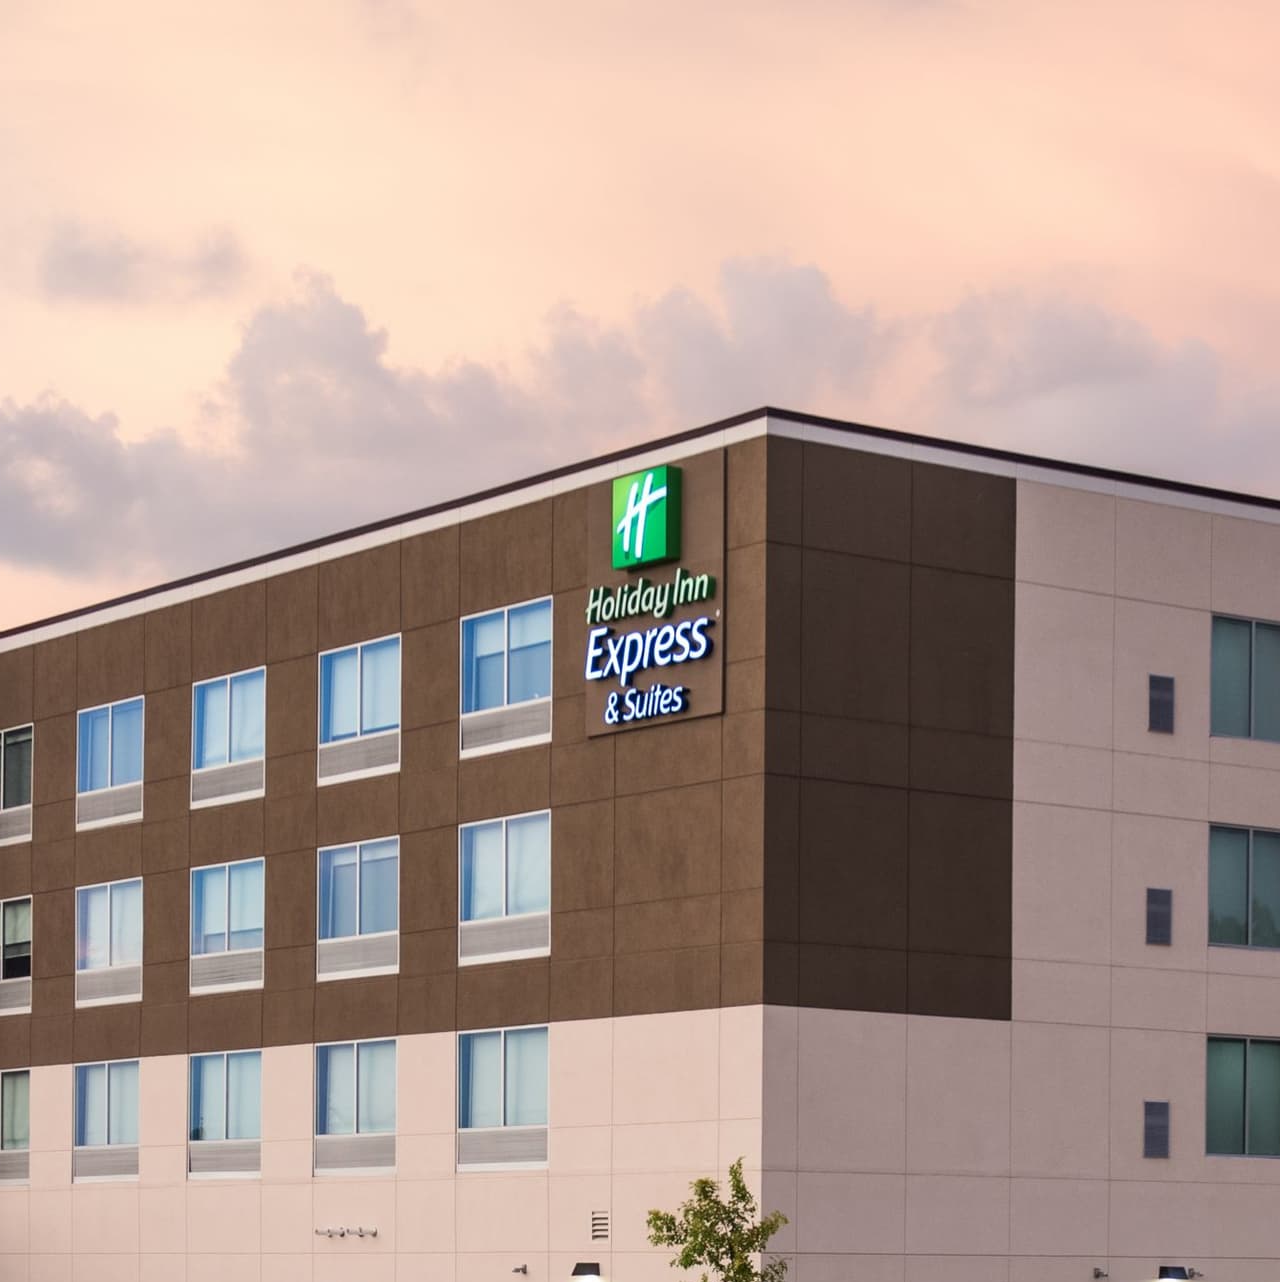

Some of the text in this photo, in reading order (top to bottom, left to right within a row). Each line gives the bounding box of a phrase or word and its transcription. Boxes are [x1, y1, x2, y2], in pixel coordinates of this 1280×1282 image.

[585, 567, 709, 625] Holiday Inn
[584, 617, 708, 687] Express
[604, 684, 683, 725] & Suites
